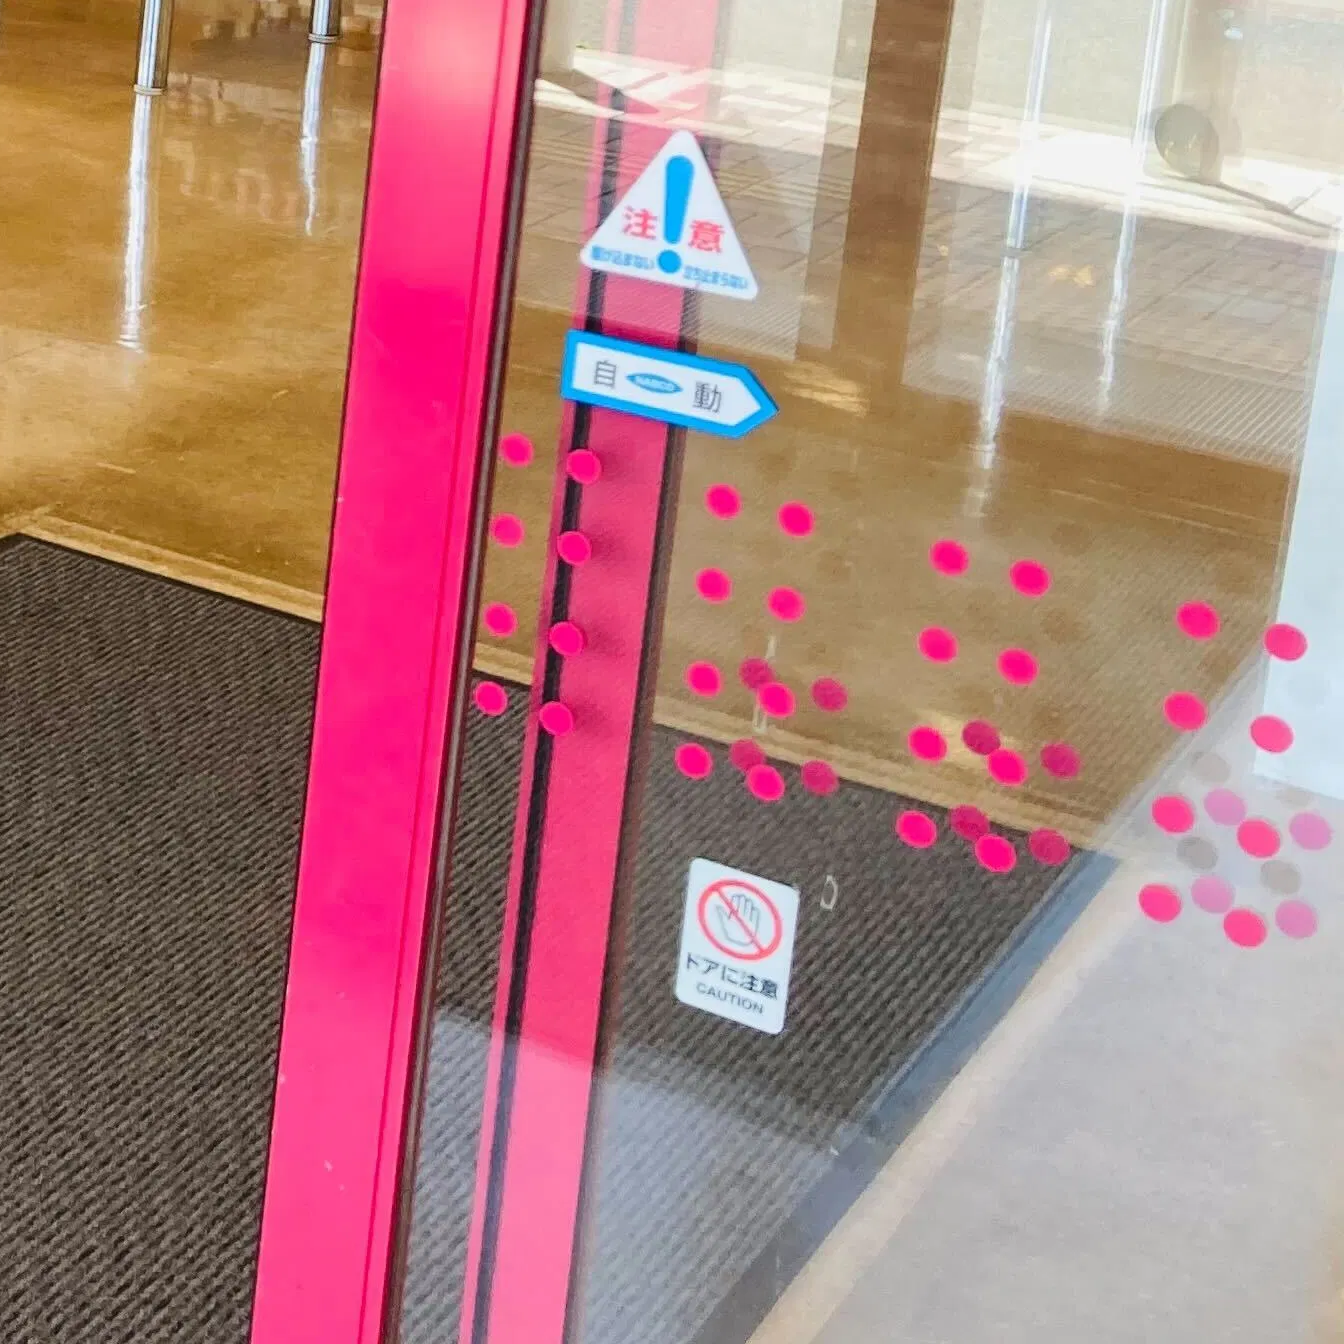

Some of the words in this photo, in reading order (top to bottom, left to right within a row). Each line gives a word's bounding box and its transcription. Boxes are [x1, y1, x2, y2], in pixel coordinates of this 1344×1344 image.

[685, 952, 778, 1000] ドアに注意
[696, 982, 764, 1015] CAUTION
